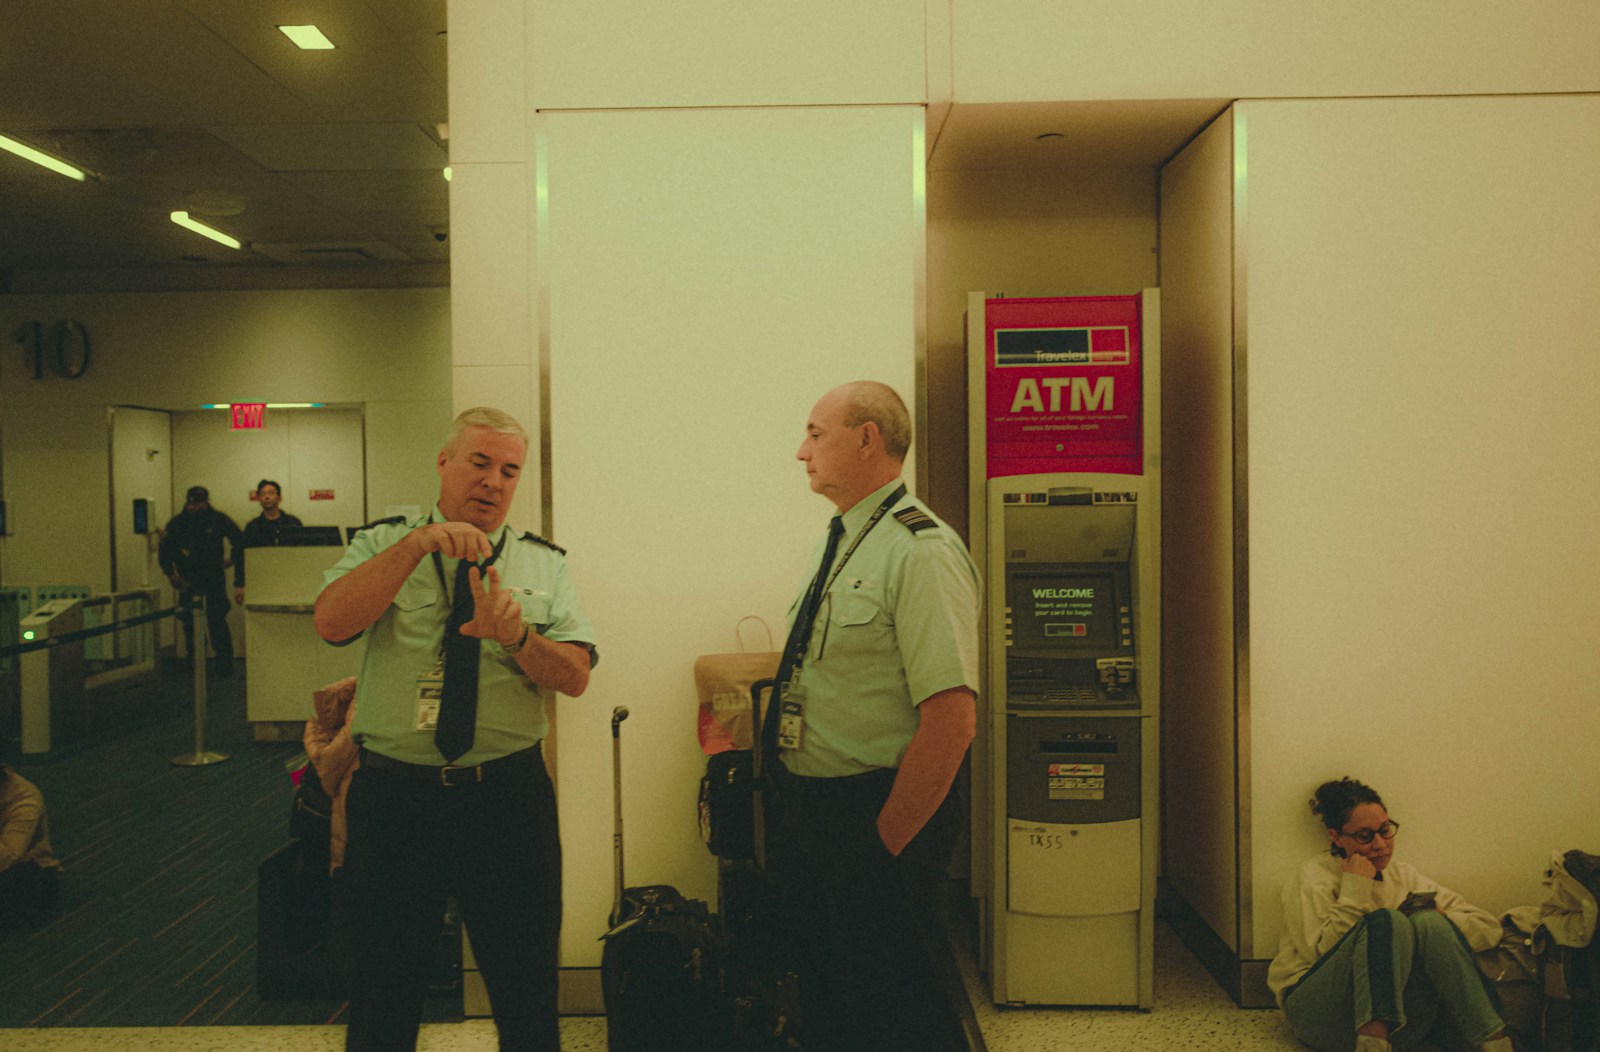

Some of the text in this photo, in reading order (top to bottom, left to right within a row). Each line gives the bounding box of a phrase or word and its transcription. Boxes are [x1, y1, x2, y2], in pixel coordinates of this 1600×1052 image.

[14, 319, 91, 379] 10
[1034, 350, 1086, 362] Travelex
[1010, 376, 1114, 413] ATM
[233, 404, 263, 429] EXIT
[1032, 588, 1094, 598] WELCOME
